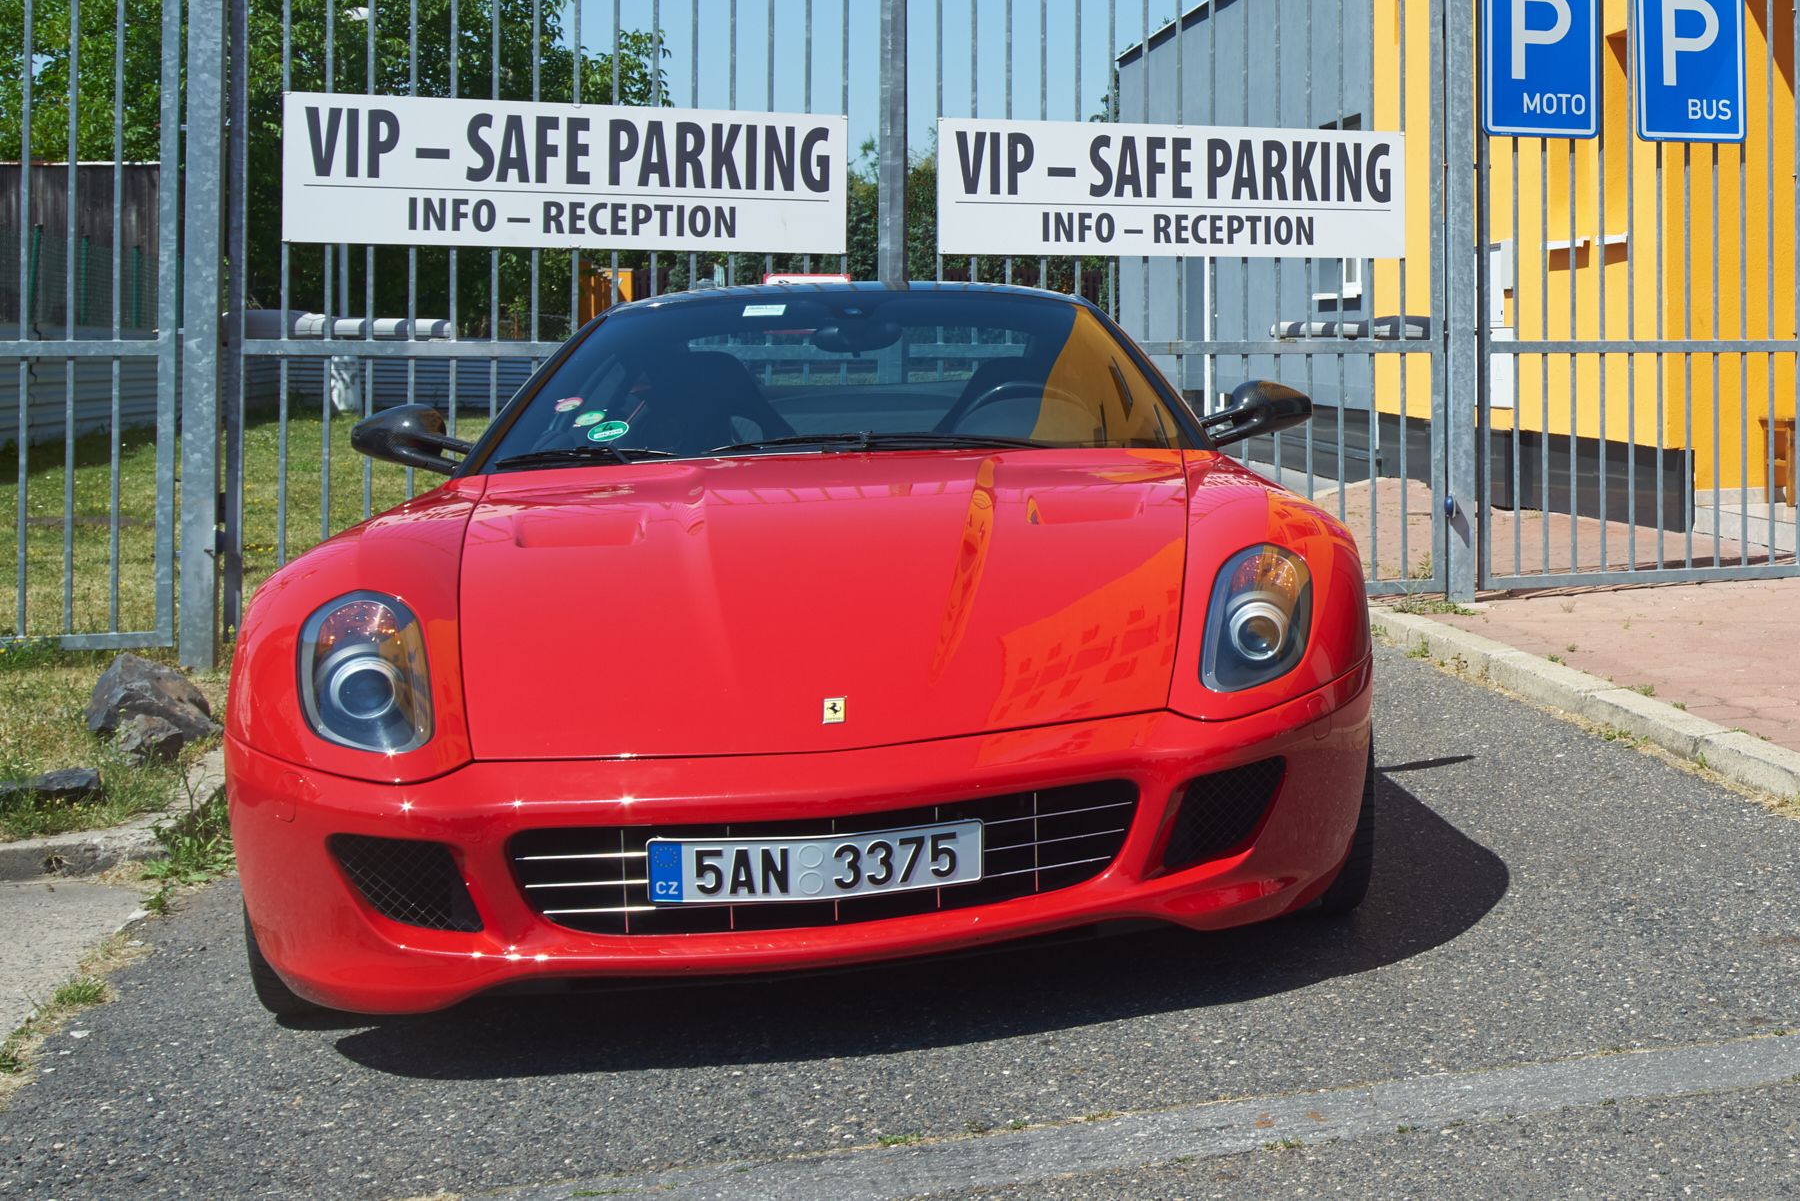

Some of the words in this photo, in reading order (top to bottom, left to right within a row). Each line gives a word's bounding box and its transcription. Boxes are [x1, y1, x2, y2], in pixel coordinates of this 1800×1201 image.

[1523, 93, 1586, 115] MOTO
[1687, 98, 1731, 120] BUS
[305, 106, 400, 179] VIP
[466, 113, 590, 185] SAFE
[608, 118, 831, 193] PARKING
[956, 131, 1034, 195] VIP
[1089, 134, 1192, 199] SAFE
[1207, 138, 1391, 203] PARKING
[408, 197, 496, 232] INFO
[543, 200, 737, 238] RECEPTION
[1042, 211, 1115, 243] INFO
[1154, 214, 1314, 246] RECEPTION
[694, 846, 789, 895] 5AN
[832, 831, 957, 890] 3375
[655, 881, 679, 896] CZ
